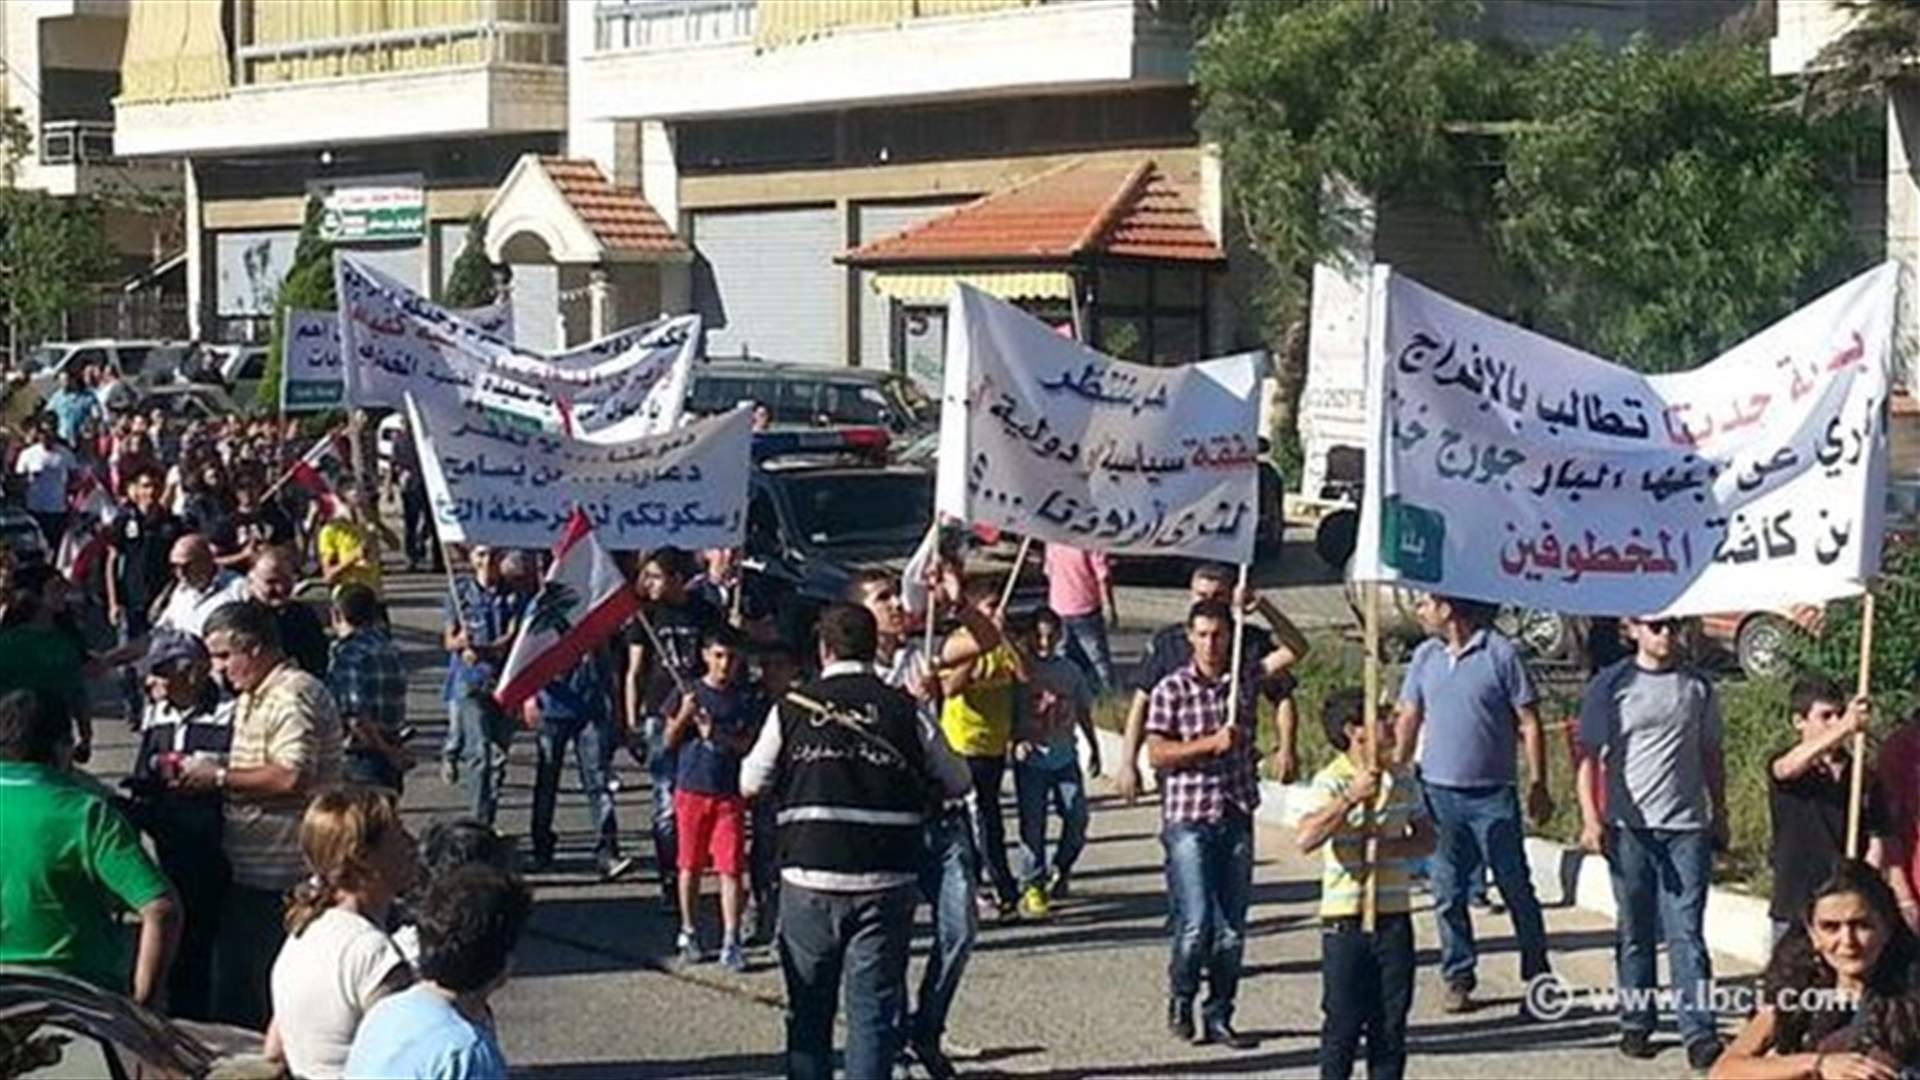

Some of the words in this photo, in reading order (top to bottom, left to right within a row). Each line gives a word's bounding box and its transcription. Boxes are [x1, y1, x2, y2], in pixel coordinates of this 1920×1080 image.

[1537, 389, 1649, 439] تطالب
[1436, 427, 1527, 491] جورج
[1501, 522, 1693, 583] المخطوفين
